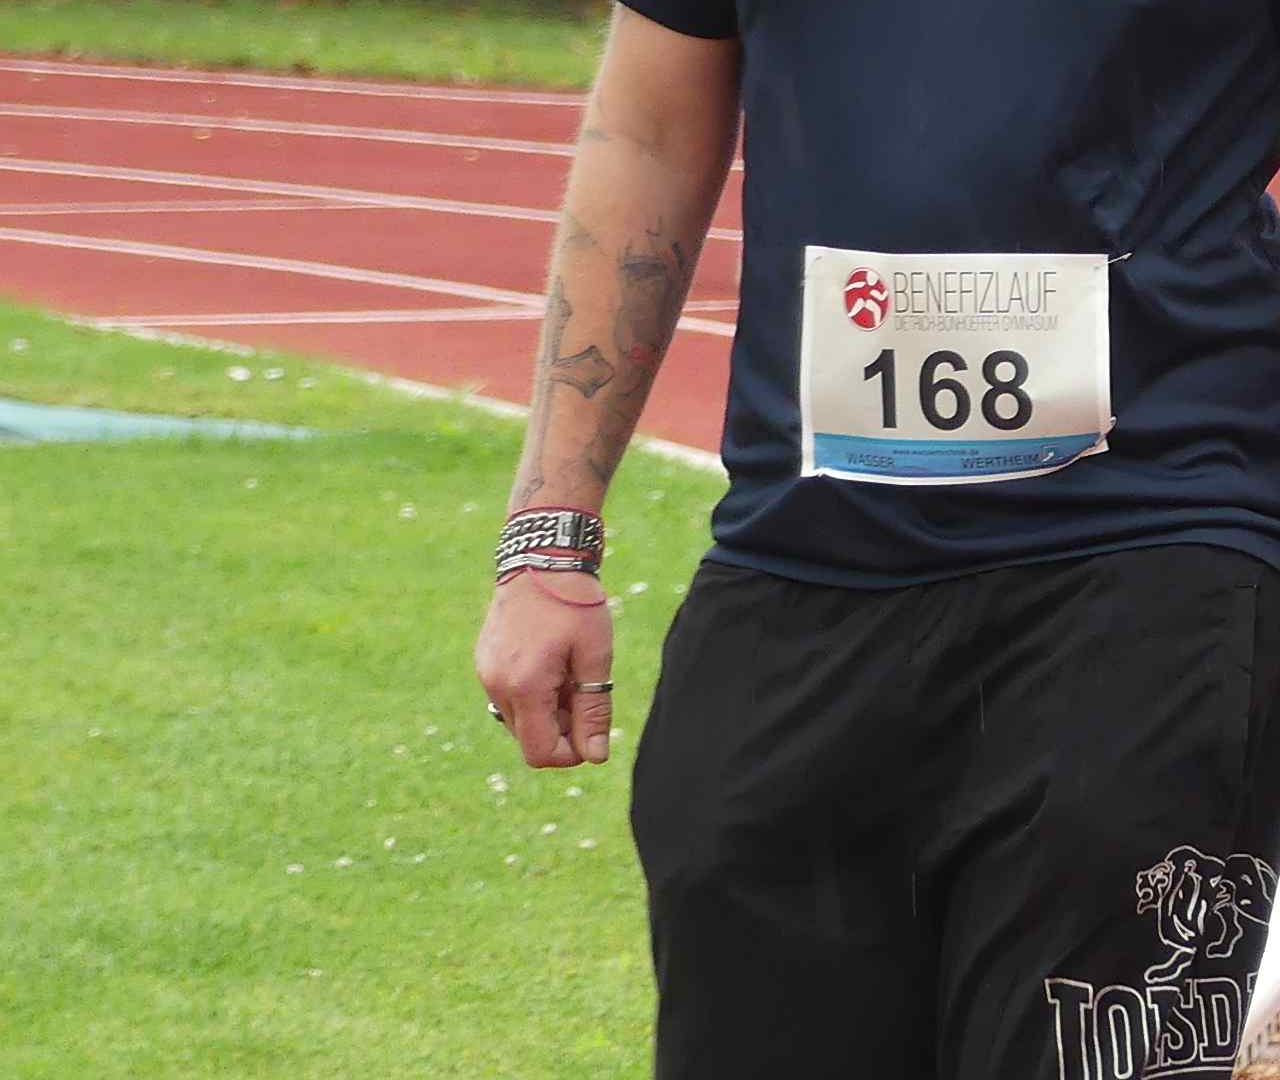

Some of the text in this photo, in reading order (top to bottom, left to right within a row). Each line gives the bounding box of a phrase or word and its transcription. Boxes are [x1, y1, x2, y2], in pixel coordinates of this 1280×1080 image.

[893, 271, 1058, 314] BENEFIZLAUF
[863, 349, 1034, 432] 168
[960, 453, 1041, 470] WERTHEIM
